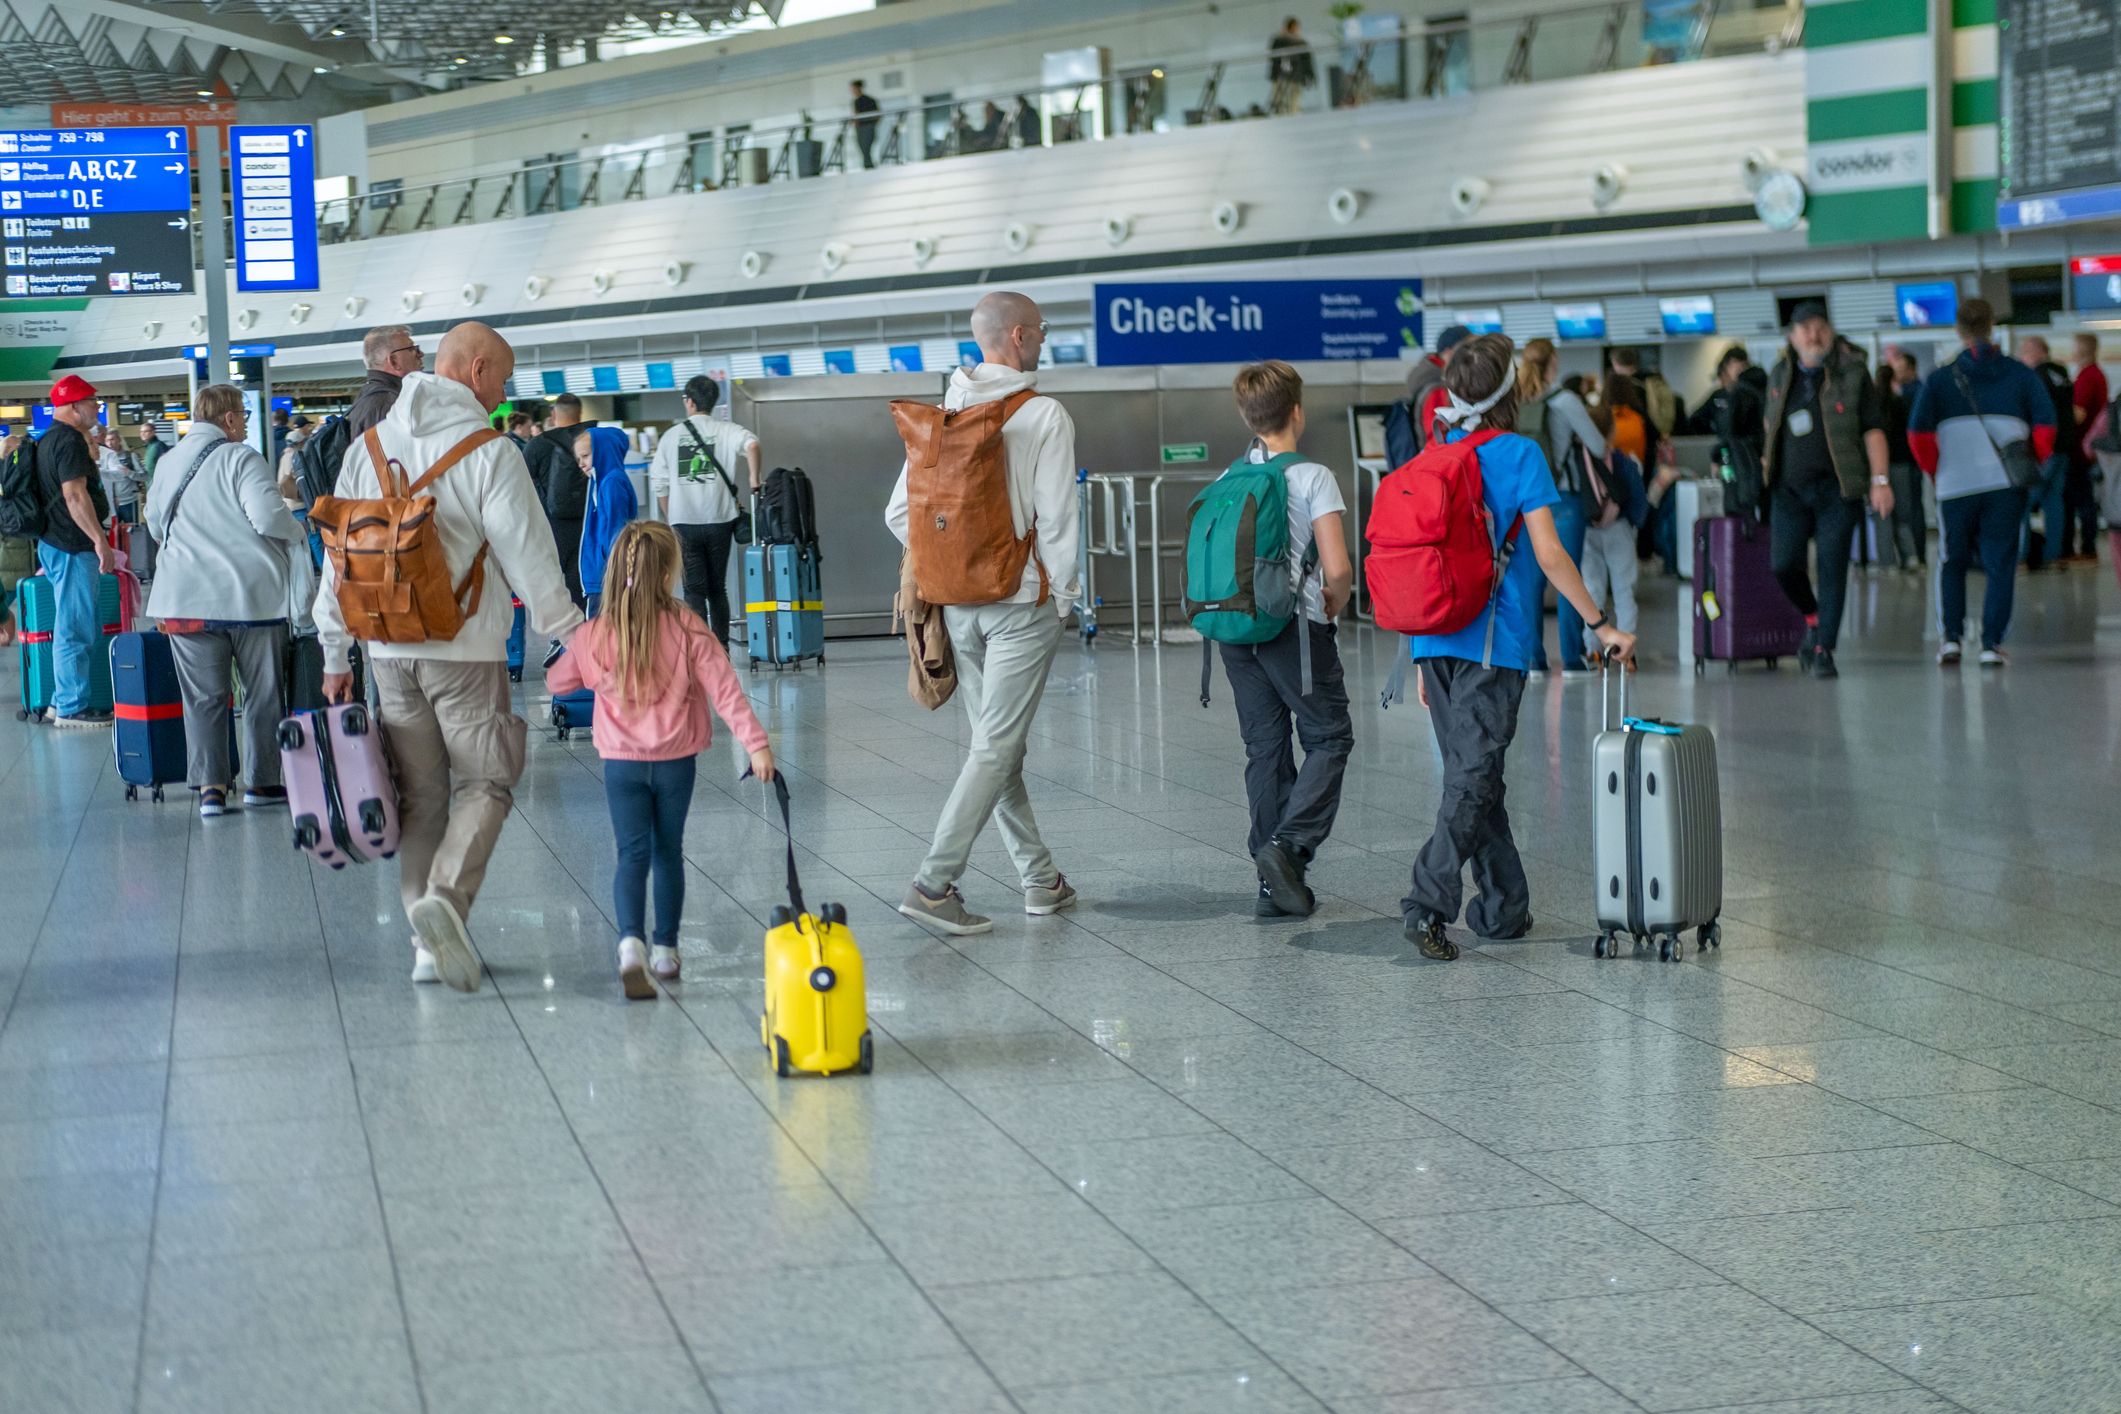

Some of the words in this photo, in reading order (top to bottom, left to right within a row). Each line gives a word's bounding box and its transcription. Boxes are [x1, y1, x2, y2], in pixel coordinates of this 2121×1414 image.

[61, 110, 93, 125] Hier
[149, 110, 181, 122] zum
[20, 133, 53, 142] Schalter
[20, 143, 53, 152] Counter
[22, 161, 49, 172] Abflug
[1816, 148, 1895, 178] condor
[22, 172, 65, 182] Departures
[22, 190, 57, 199] Terminal
[25, 218, 61, 227] Toiletten
[26, 228, 53, 237] Toilets
[28, 256, 54, 267] Export
[54, 255, 103, 265] certification
[28, 274, 97, 283] Besucherzentrum
[131, 271, 161, 282] Airport
[61, 284, 88, 293] Center
[131, 282, 154, 291] Tours
[160, 280, 182, 292] Shop
[1109, 295, 1264, 335] Check-in
